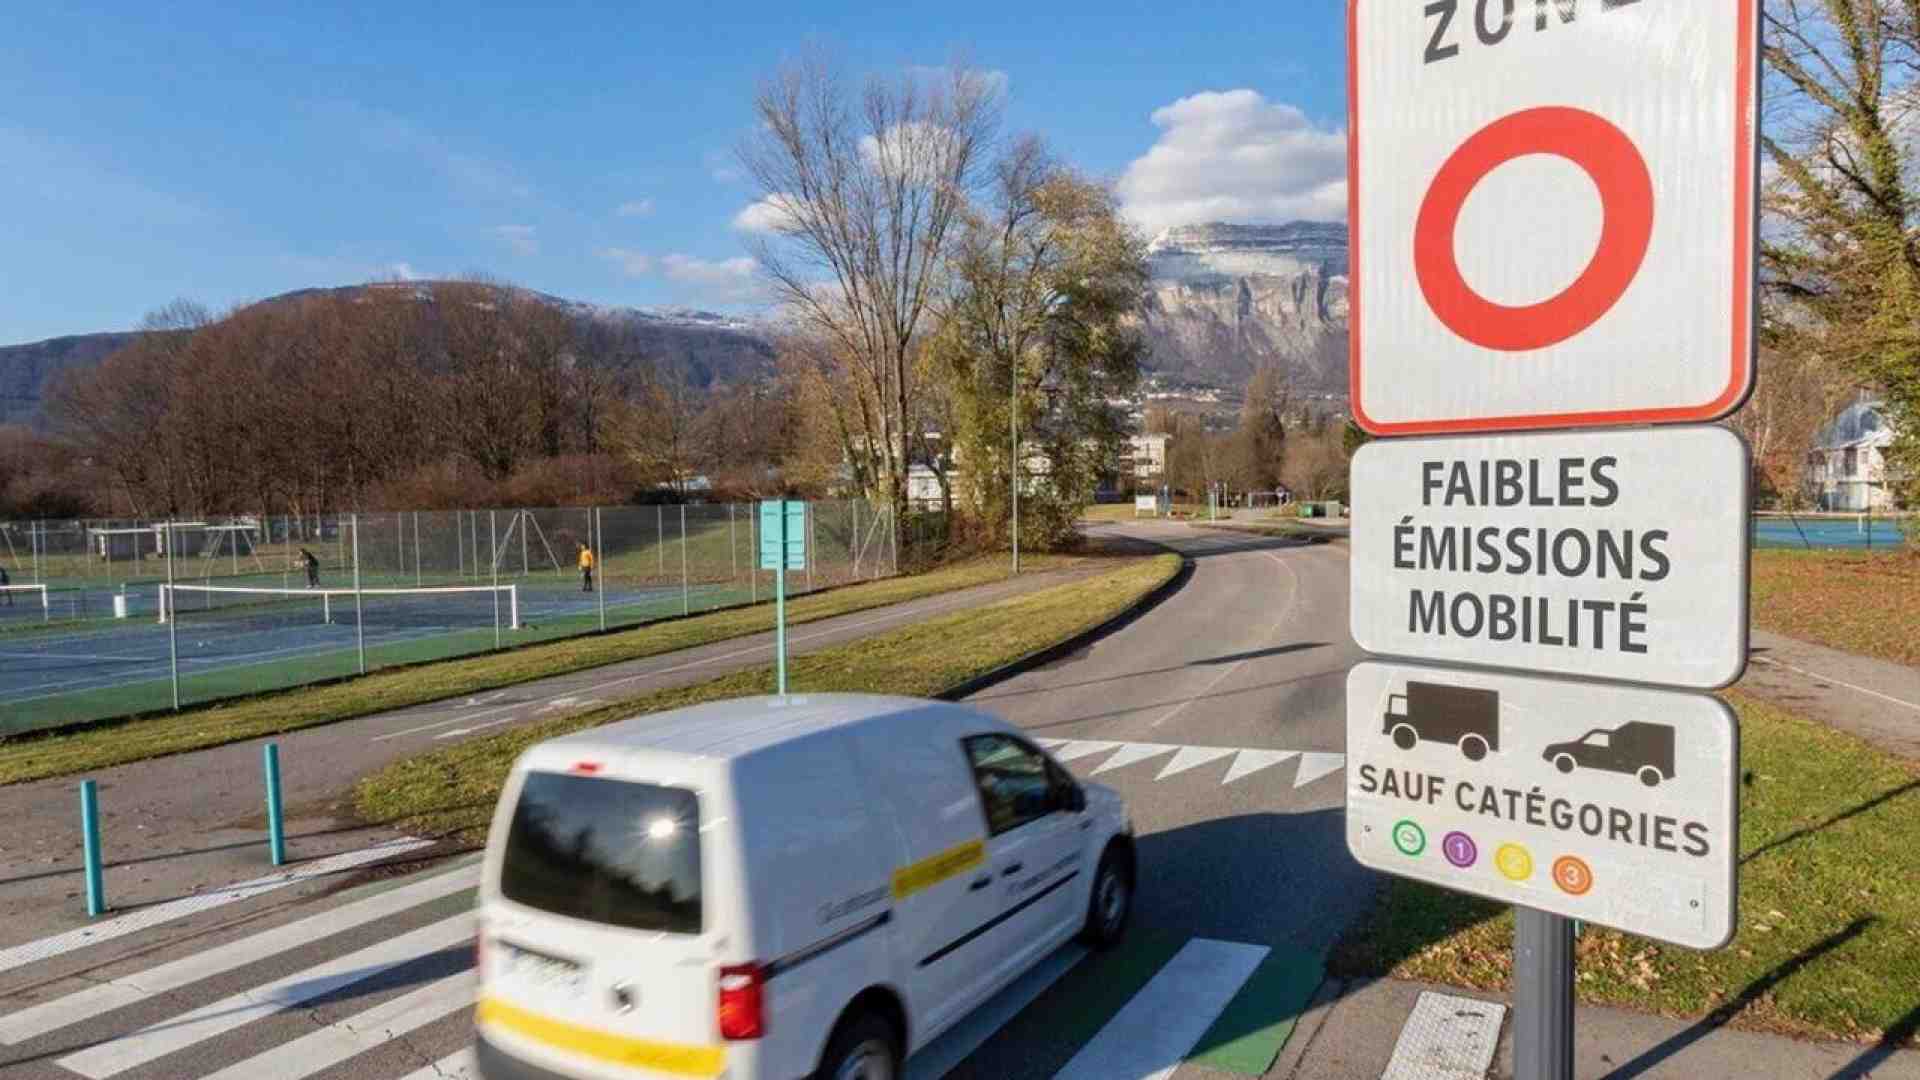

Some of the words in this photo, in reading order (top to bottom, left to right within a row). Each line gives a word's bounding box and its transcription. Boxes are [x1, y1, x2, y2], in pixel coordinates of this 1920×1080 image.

[1422, 456, 1619, 507] FAIBLES
[1394, 515, 1670, 581] ÉMISSIONS
[1408, 589, 1648, 653] MOBILITÉ
[1360, 764, 1445, 804] SAUF
[1455, 782, 1710, 858] CATÉGORIES
